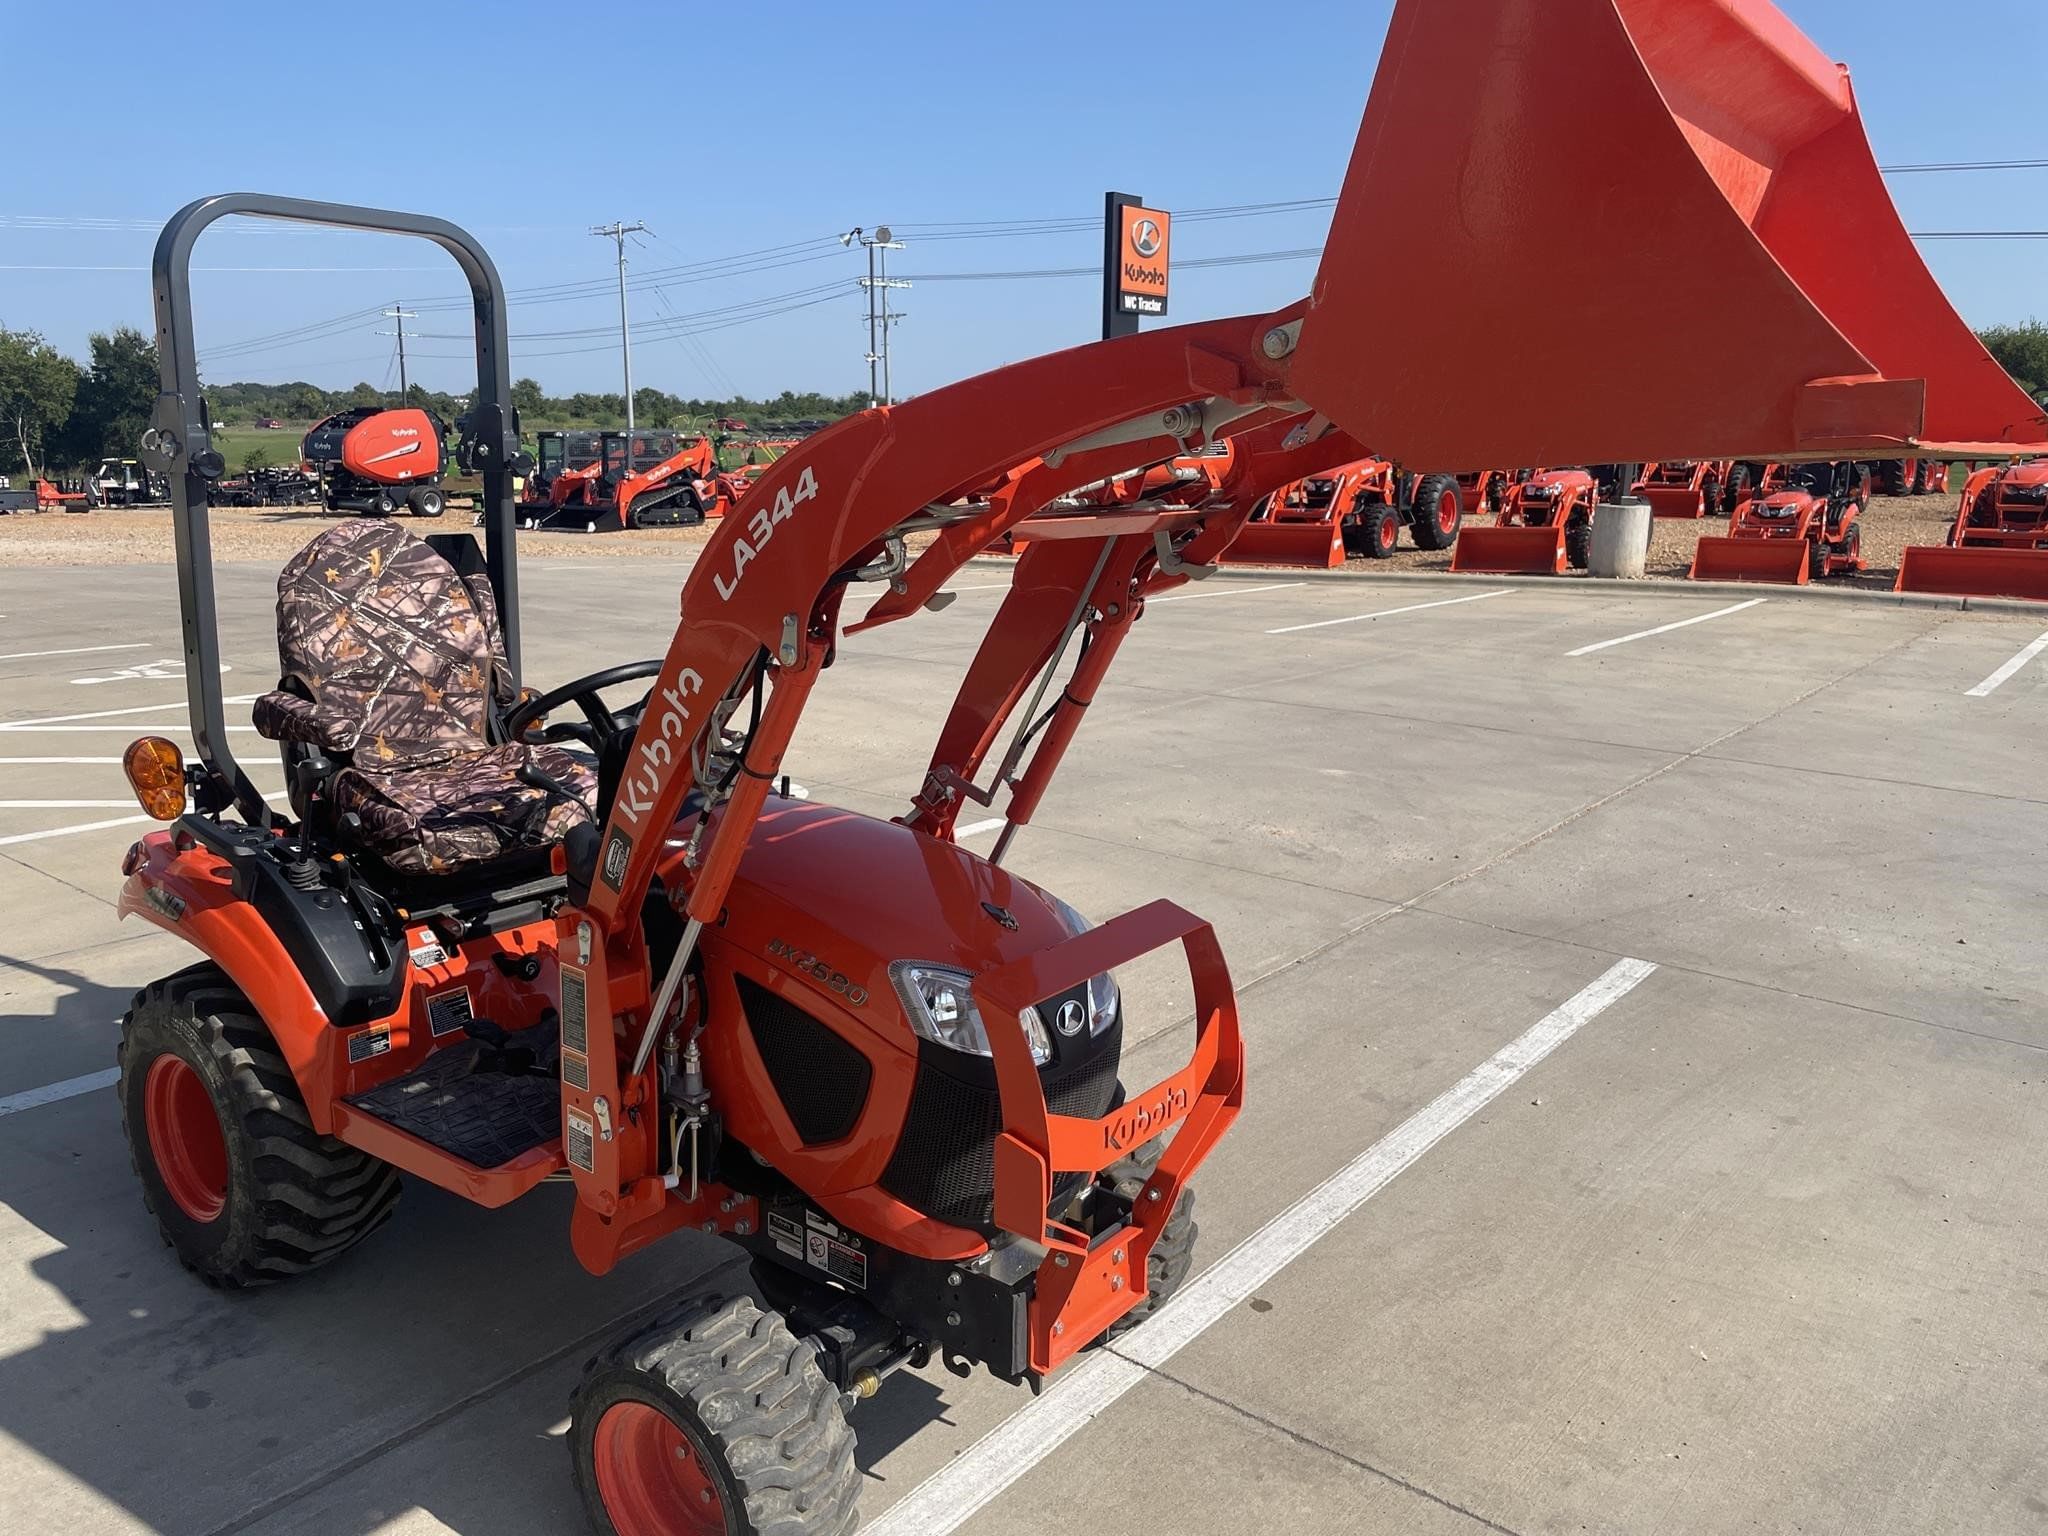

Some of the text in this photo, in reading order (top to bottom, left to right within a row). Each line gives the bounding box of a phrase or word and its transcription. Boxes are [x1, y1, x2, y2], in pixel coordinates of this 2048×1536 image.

[1124, 295, 1162, 312] WC Tractor
[1125, 263, 1165, 285] Kubota
[713, 465, 819, 601] LA344
[618, 667, 704, 824] Kubota
[1104, 1088, 1187, 1150] Kubota
